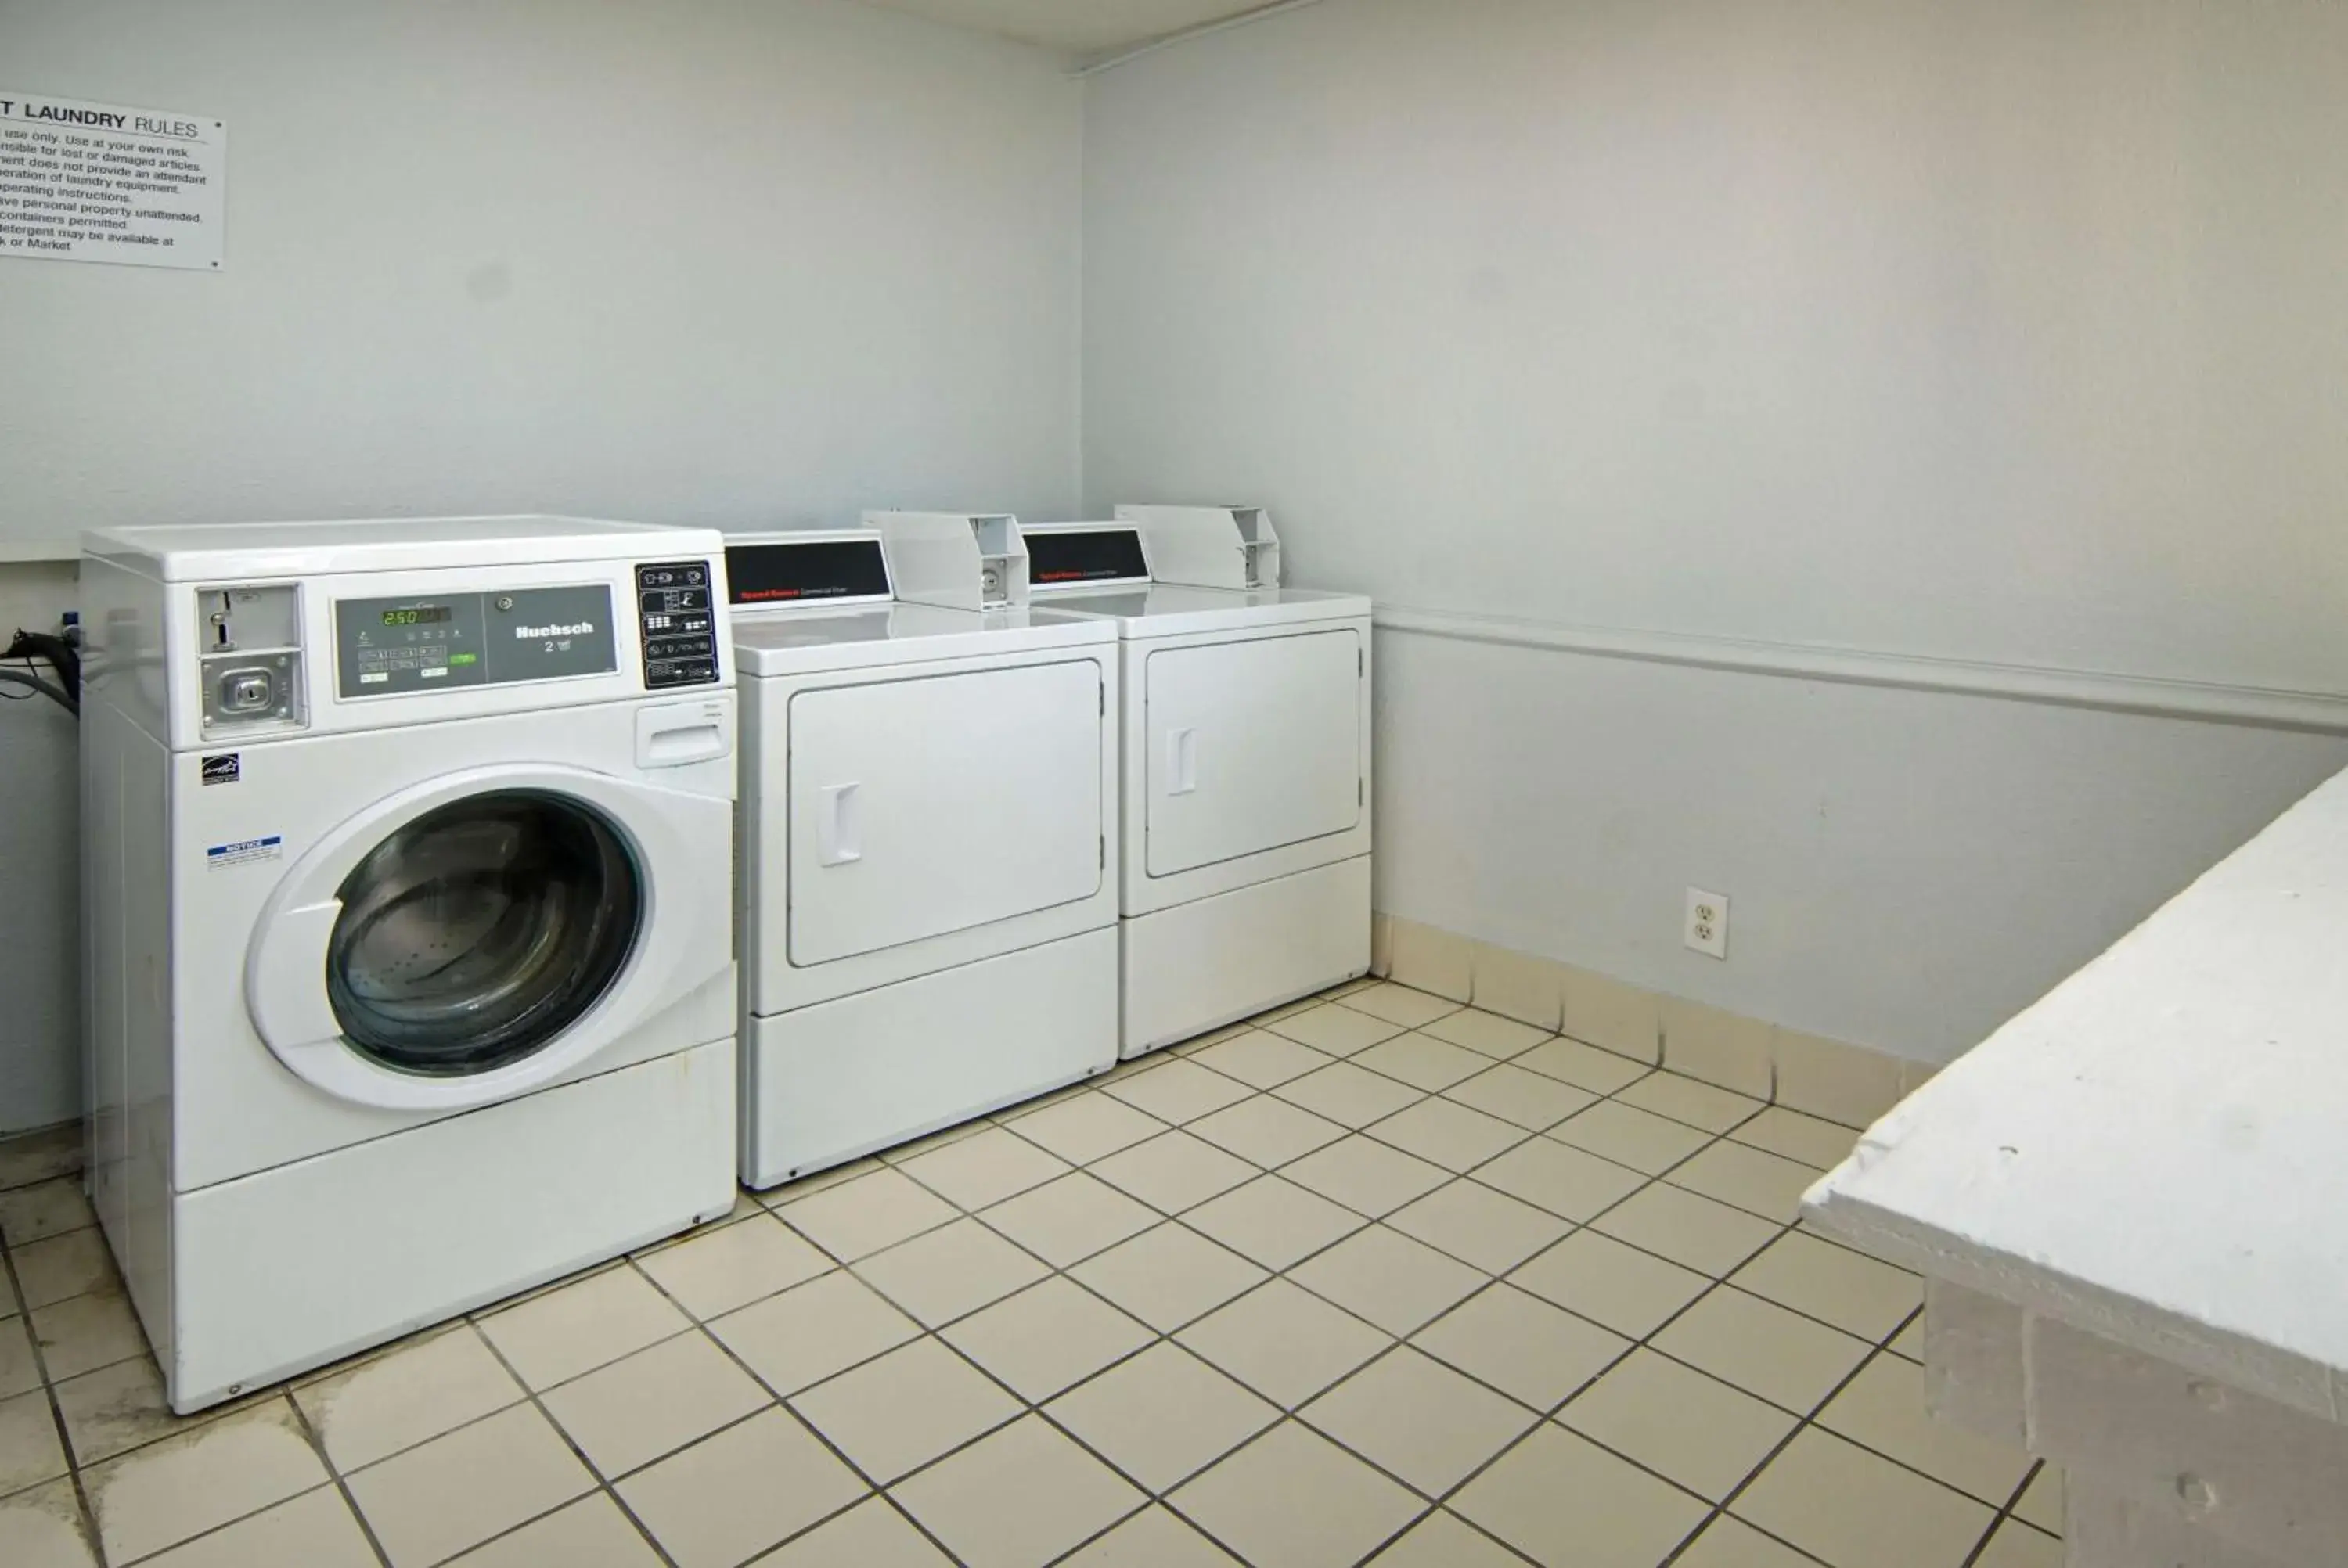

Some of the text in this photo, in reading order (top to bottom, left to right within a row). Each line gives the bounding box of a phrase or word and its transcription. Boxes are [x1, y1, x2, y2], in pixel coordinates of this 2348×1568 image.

[25, 103, 126, 128] LAUNDRY
[135, 117, 199, 138] RULES
[5, 130, 28, 140] use
[66, 135, 88, 146] Use
[93, 139, 104, 148] at
[109, 142, 135, 151] your
[139, 144, 164, 154] own
[41, 146, 57, 156] for
[61, 148, 82, 158] lost
[87, 152, 99, 160] or
[103, 153, 156, 167] damaged
[29, 158, 60, 170] does
[64, 162, 84, 171] not
[87, 164, 131, 177] provide
[135, 170, 149, 179] an
[153, 171, 207, 185] attendant
[0, 183, 54, 197] perating
[49, 173, 63, 183] of
[67, 174, 113, 189] laundry
[23, 199, 77, 212] personal
[81, 203, 132, 218] property
[0, 211, 65, 225] containers
[0, 224, 175, 246] etergent may be available at
[10, 238, 23, 246] or
[27, 238, 70, 250] Market
[384, 610, 417, 625] 250
[516, 621, 594, 639] Huebsch
